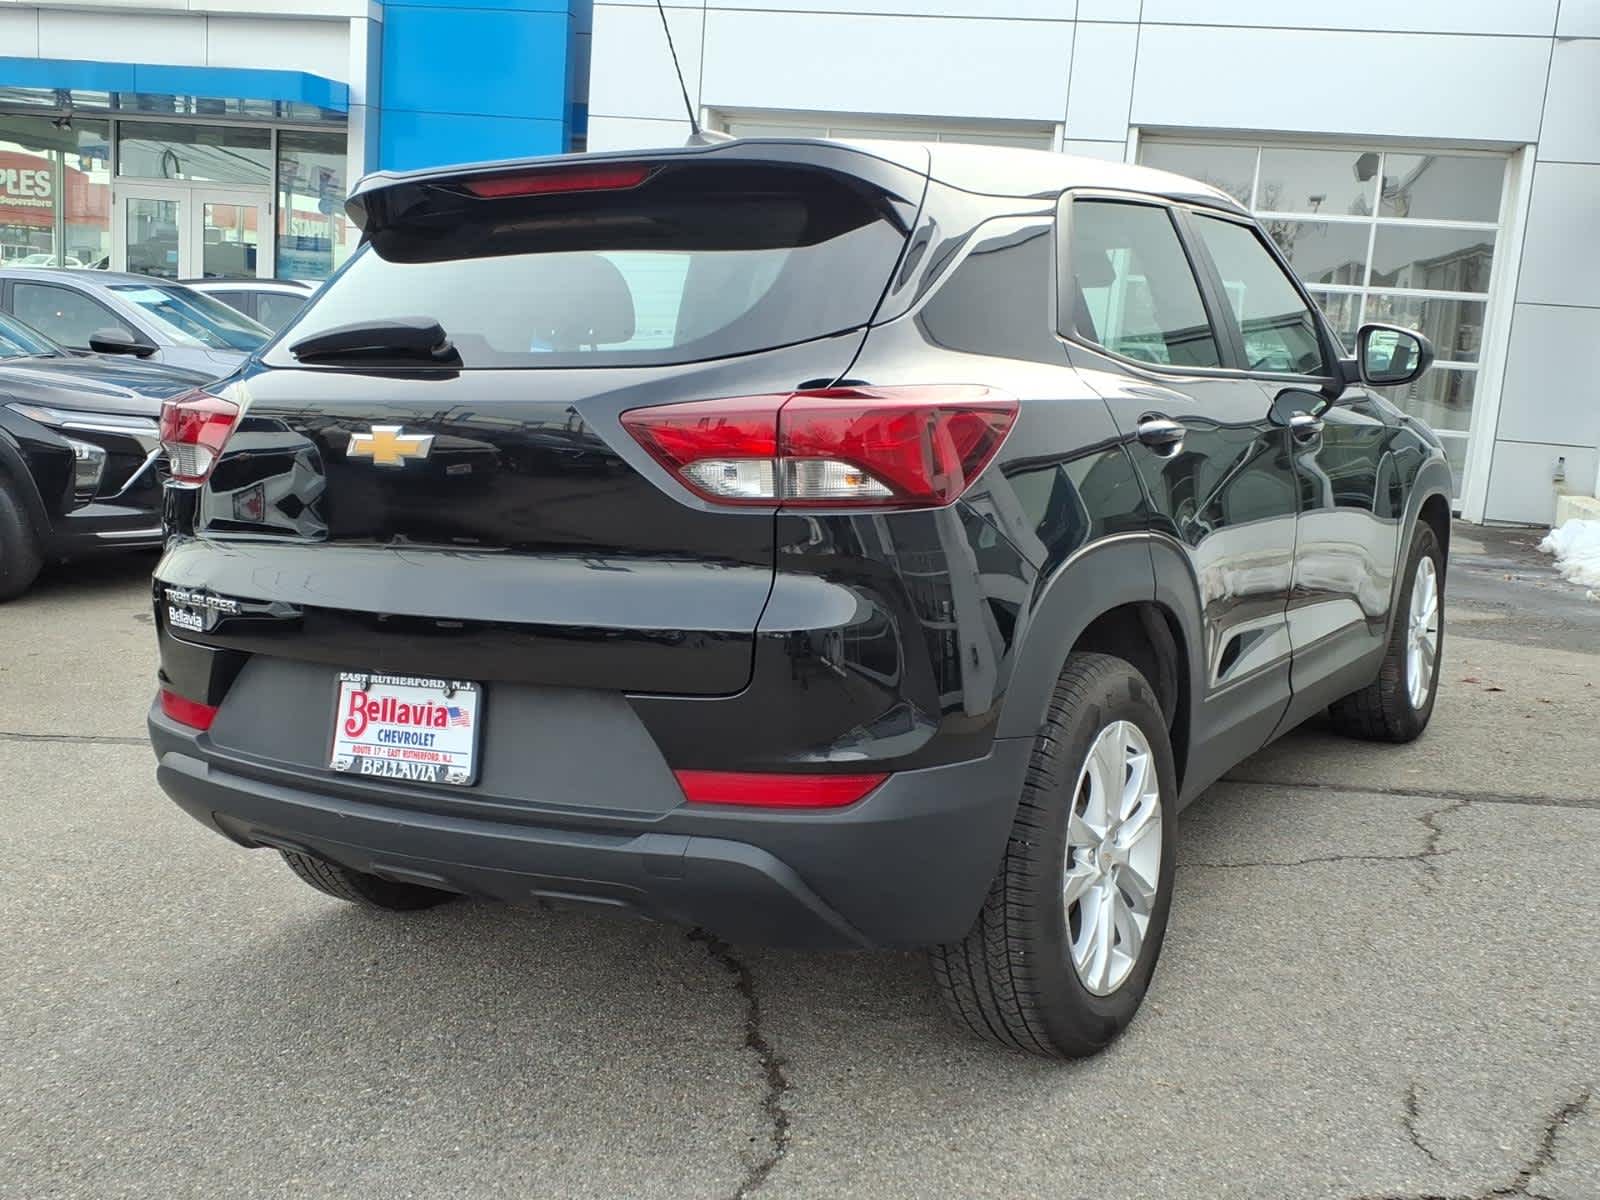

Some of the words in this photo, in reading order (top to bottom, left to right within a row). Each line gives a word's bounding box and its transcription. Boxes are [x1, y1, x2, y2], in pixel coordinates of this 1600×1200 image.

[339, 672, 368, 682] EAST
[345, 690, 447, 737] Bellavia
[378, 729, 436, 747] CHEVROLET
[352, 745, 371, 755] ROUTE
[373, 746, 381, 755] 17
[387, 747, 401, 758] EAST
[361, 758, 437, 782] BELLAVIA
